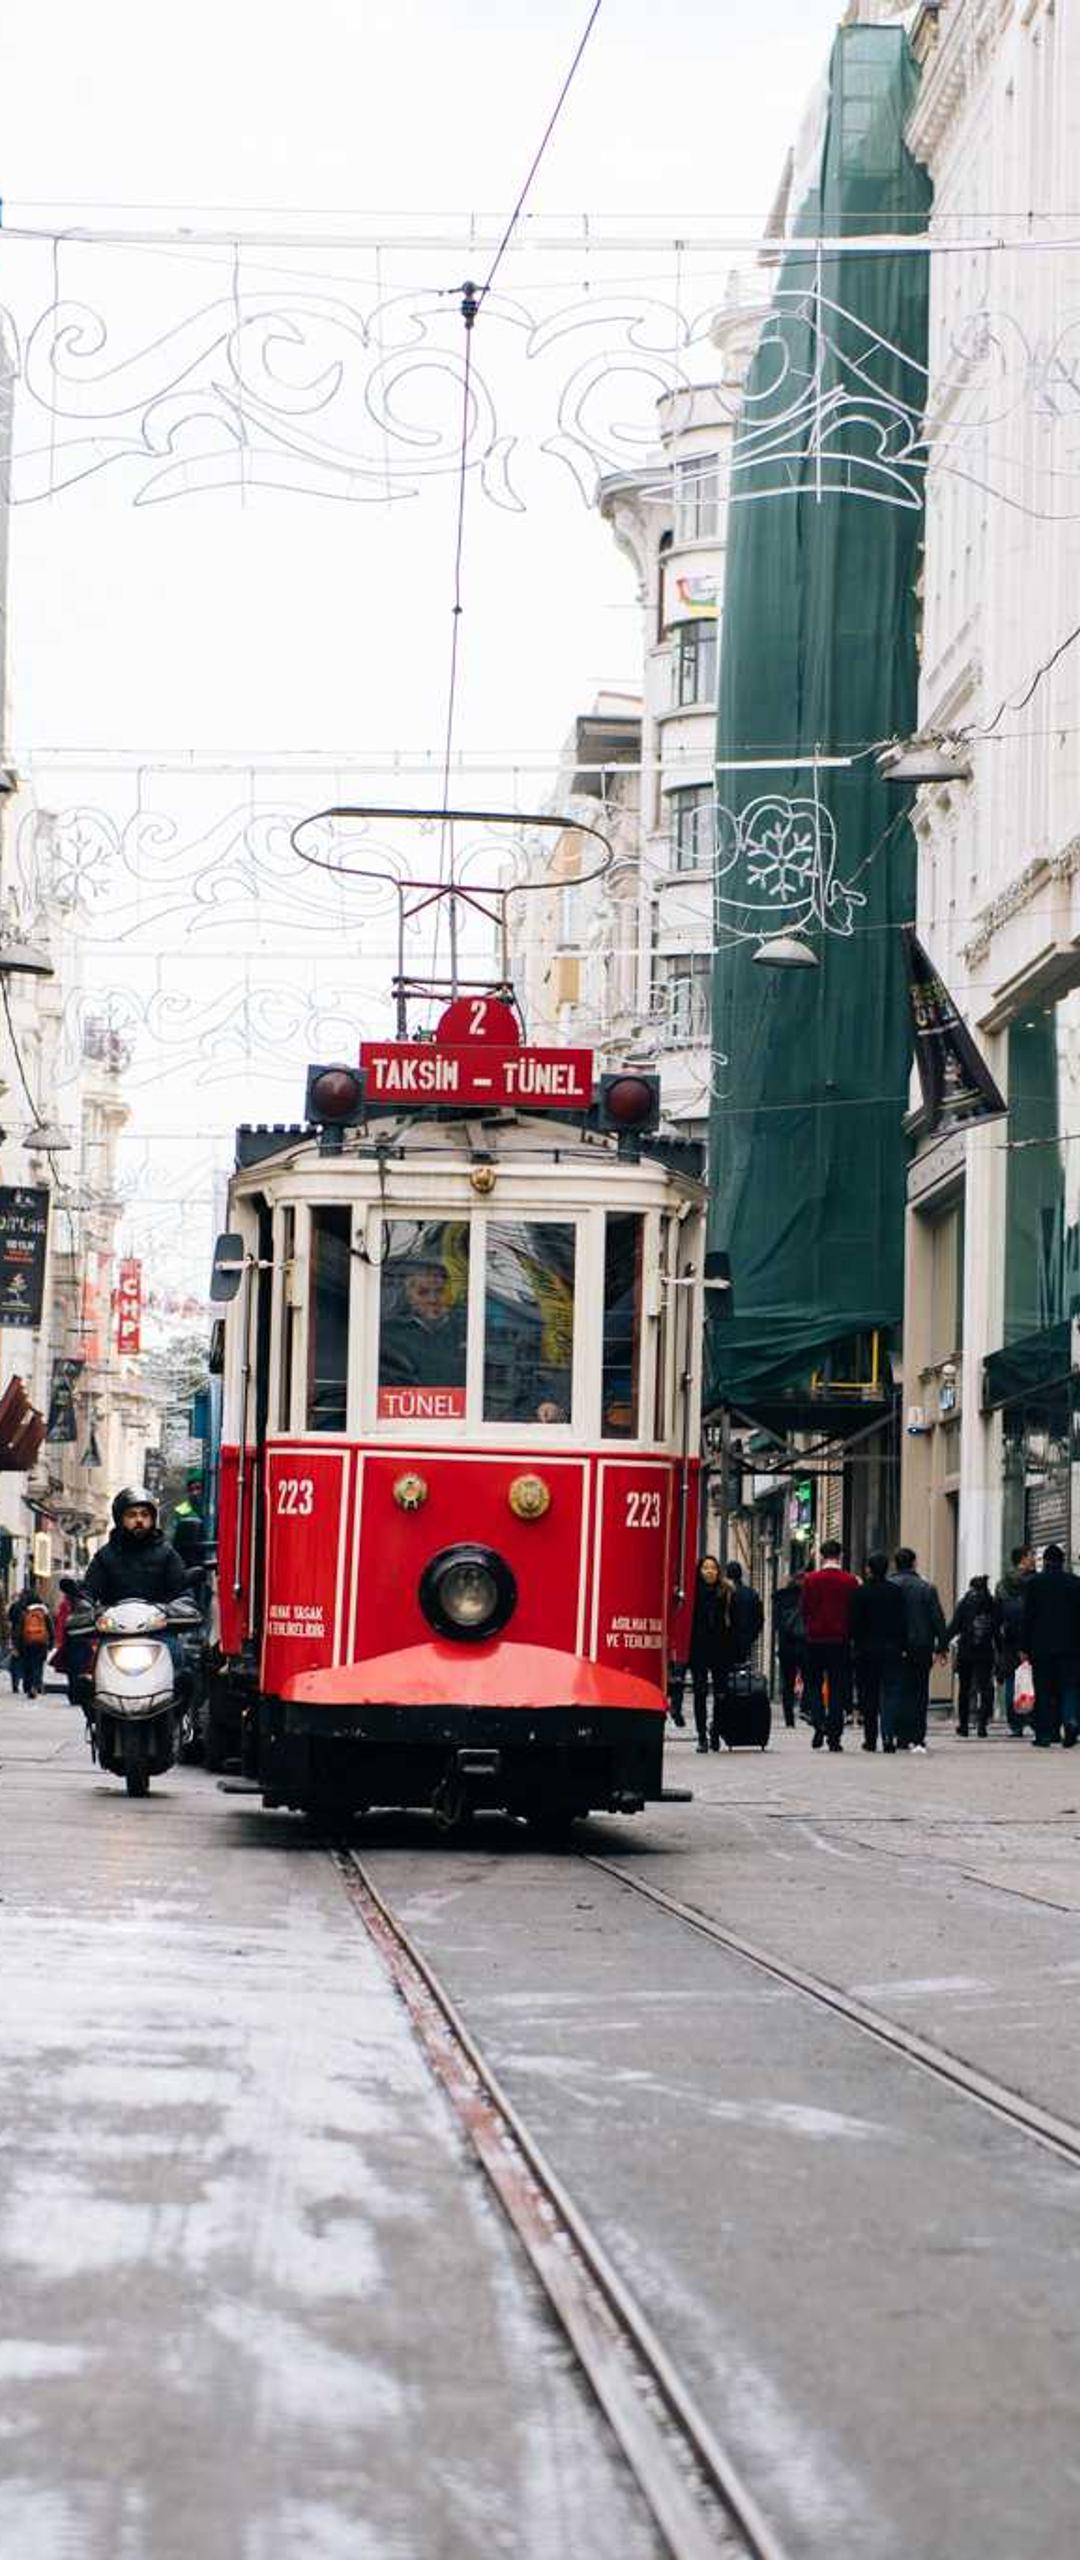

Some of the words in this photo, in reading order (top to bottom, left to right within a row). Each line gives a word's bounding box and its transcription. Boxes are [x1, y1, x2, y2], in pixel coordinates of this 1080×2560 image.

[468, 1001, 486, 1035] 2
[372, 1055, 458, 1091] TAKSİM
[502, 1057, 583, 1096] TÜNEL
[121, 1278, 139, 1338] CHP
[384, 1391, 461, 1416] TÜNEL
[277, 1479, 314, 1515] 223
[625, 1492, 661, 1528] 223
[606, 1633, 620, 1648] VE
